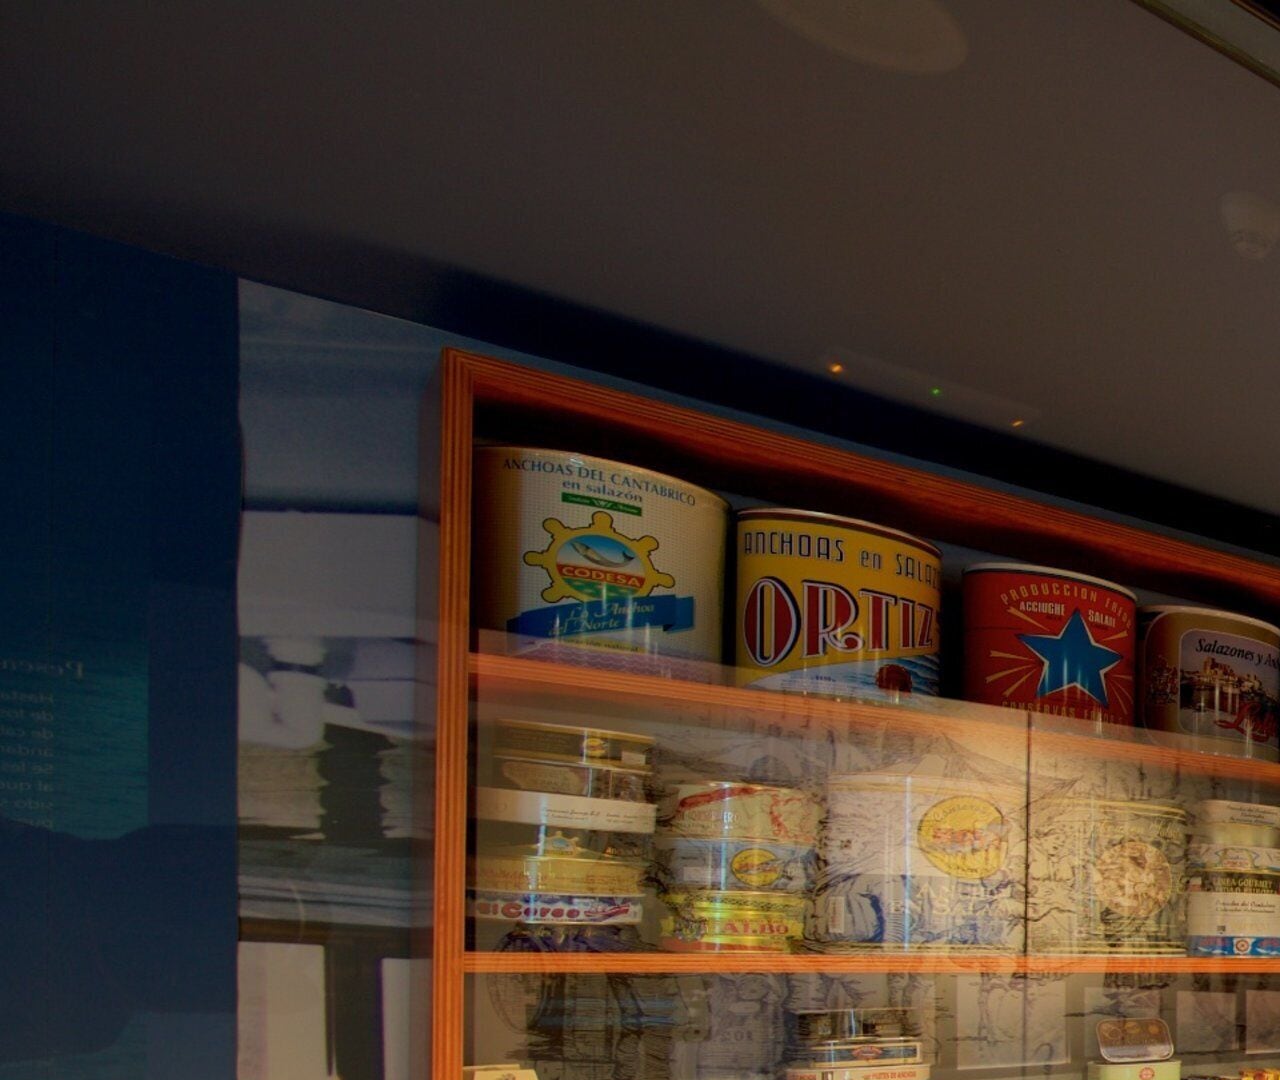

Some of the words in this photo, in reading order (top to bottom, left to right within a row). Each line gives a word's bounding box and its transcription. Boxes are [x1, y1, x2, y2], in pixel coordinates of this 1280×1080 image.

[503, 459, 573, 476] ANCHOAS
[578, 466, 605, 482] DEL
[562, 480, 581, 491] en
[586, 482, 643, 503] salazón
[744, 531, 844, 562] ANCHOAS
[861, 550, 882, 570] en
[561, 566, 641, 587] CODESA
[1000, 582, 1098, 605] PRODUCCION
[1019, 601, 1065, 616] ACCIUGHE
[743, 575, 936, 668] ORTIZ
[1195, 638, 1255, 662] Salazones
[1255, 653, 1264, 666] y
